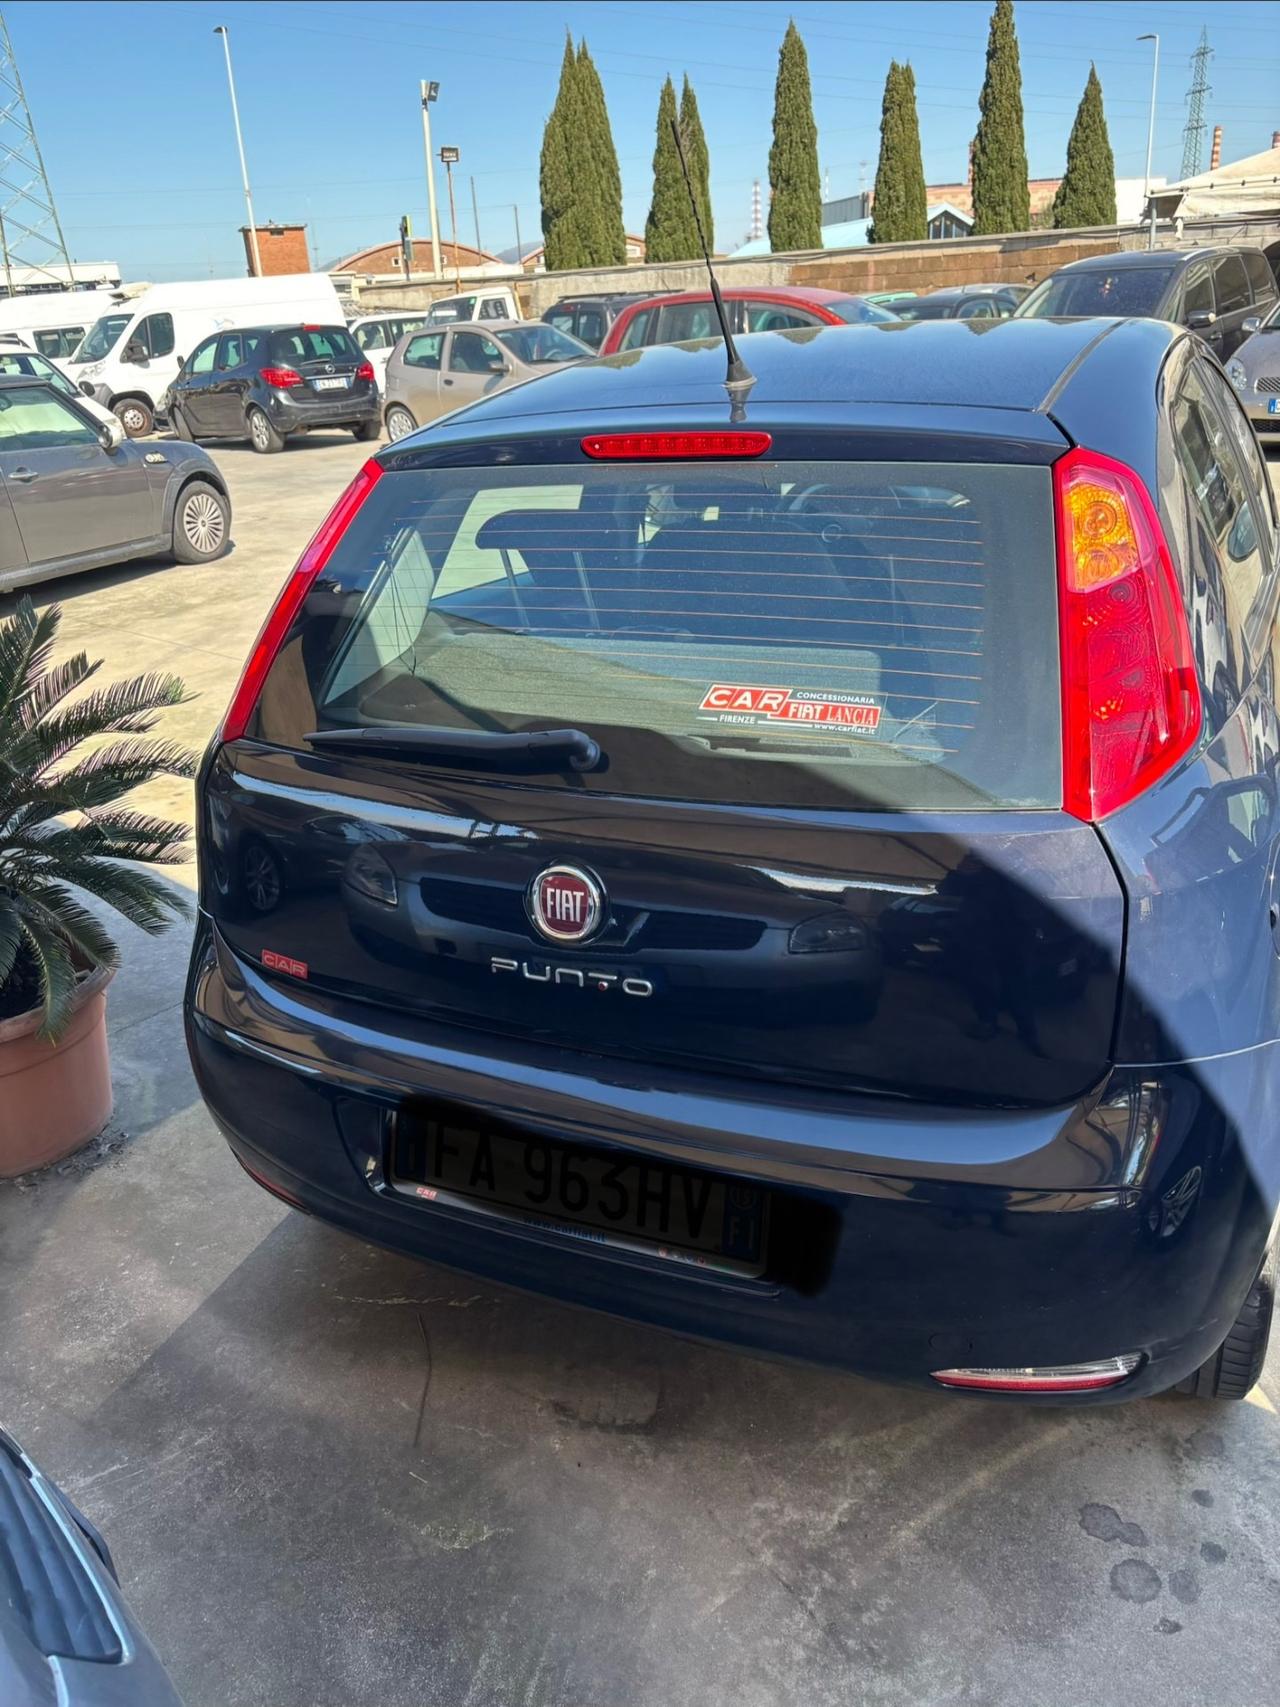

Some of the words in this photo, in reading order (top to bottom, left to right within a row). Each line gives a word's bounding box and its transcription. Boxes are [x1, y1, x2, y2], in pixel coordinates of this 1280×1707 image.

[708, 689, 785, 711] CAR
[796, 691, 875, 705] CONCESSIONARIA
[719, 714, 756, 725] FIRENZE
[788, 703, 824, 719] FIAT
[826, 707, 875, 725] LANCIA
[814, 723, 876, 735] www.carfiat.it
[546, 887, 586, 923] FIAT
[263, 953, 307, 977] CAR
[490, 956, 653, 997] PUNTO
